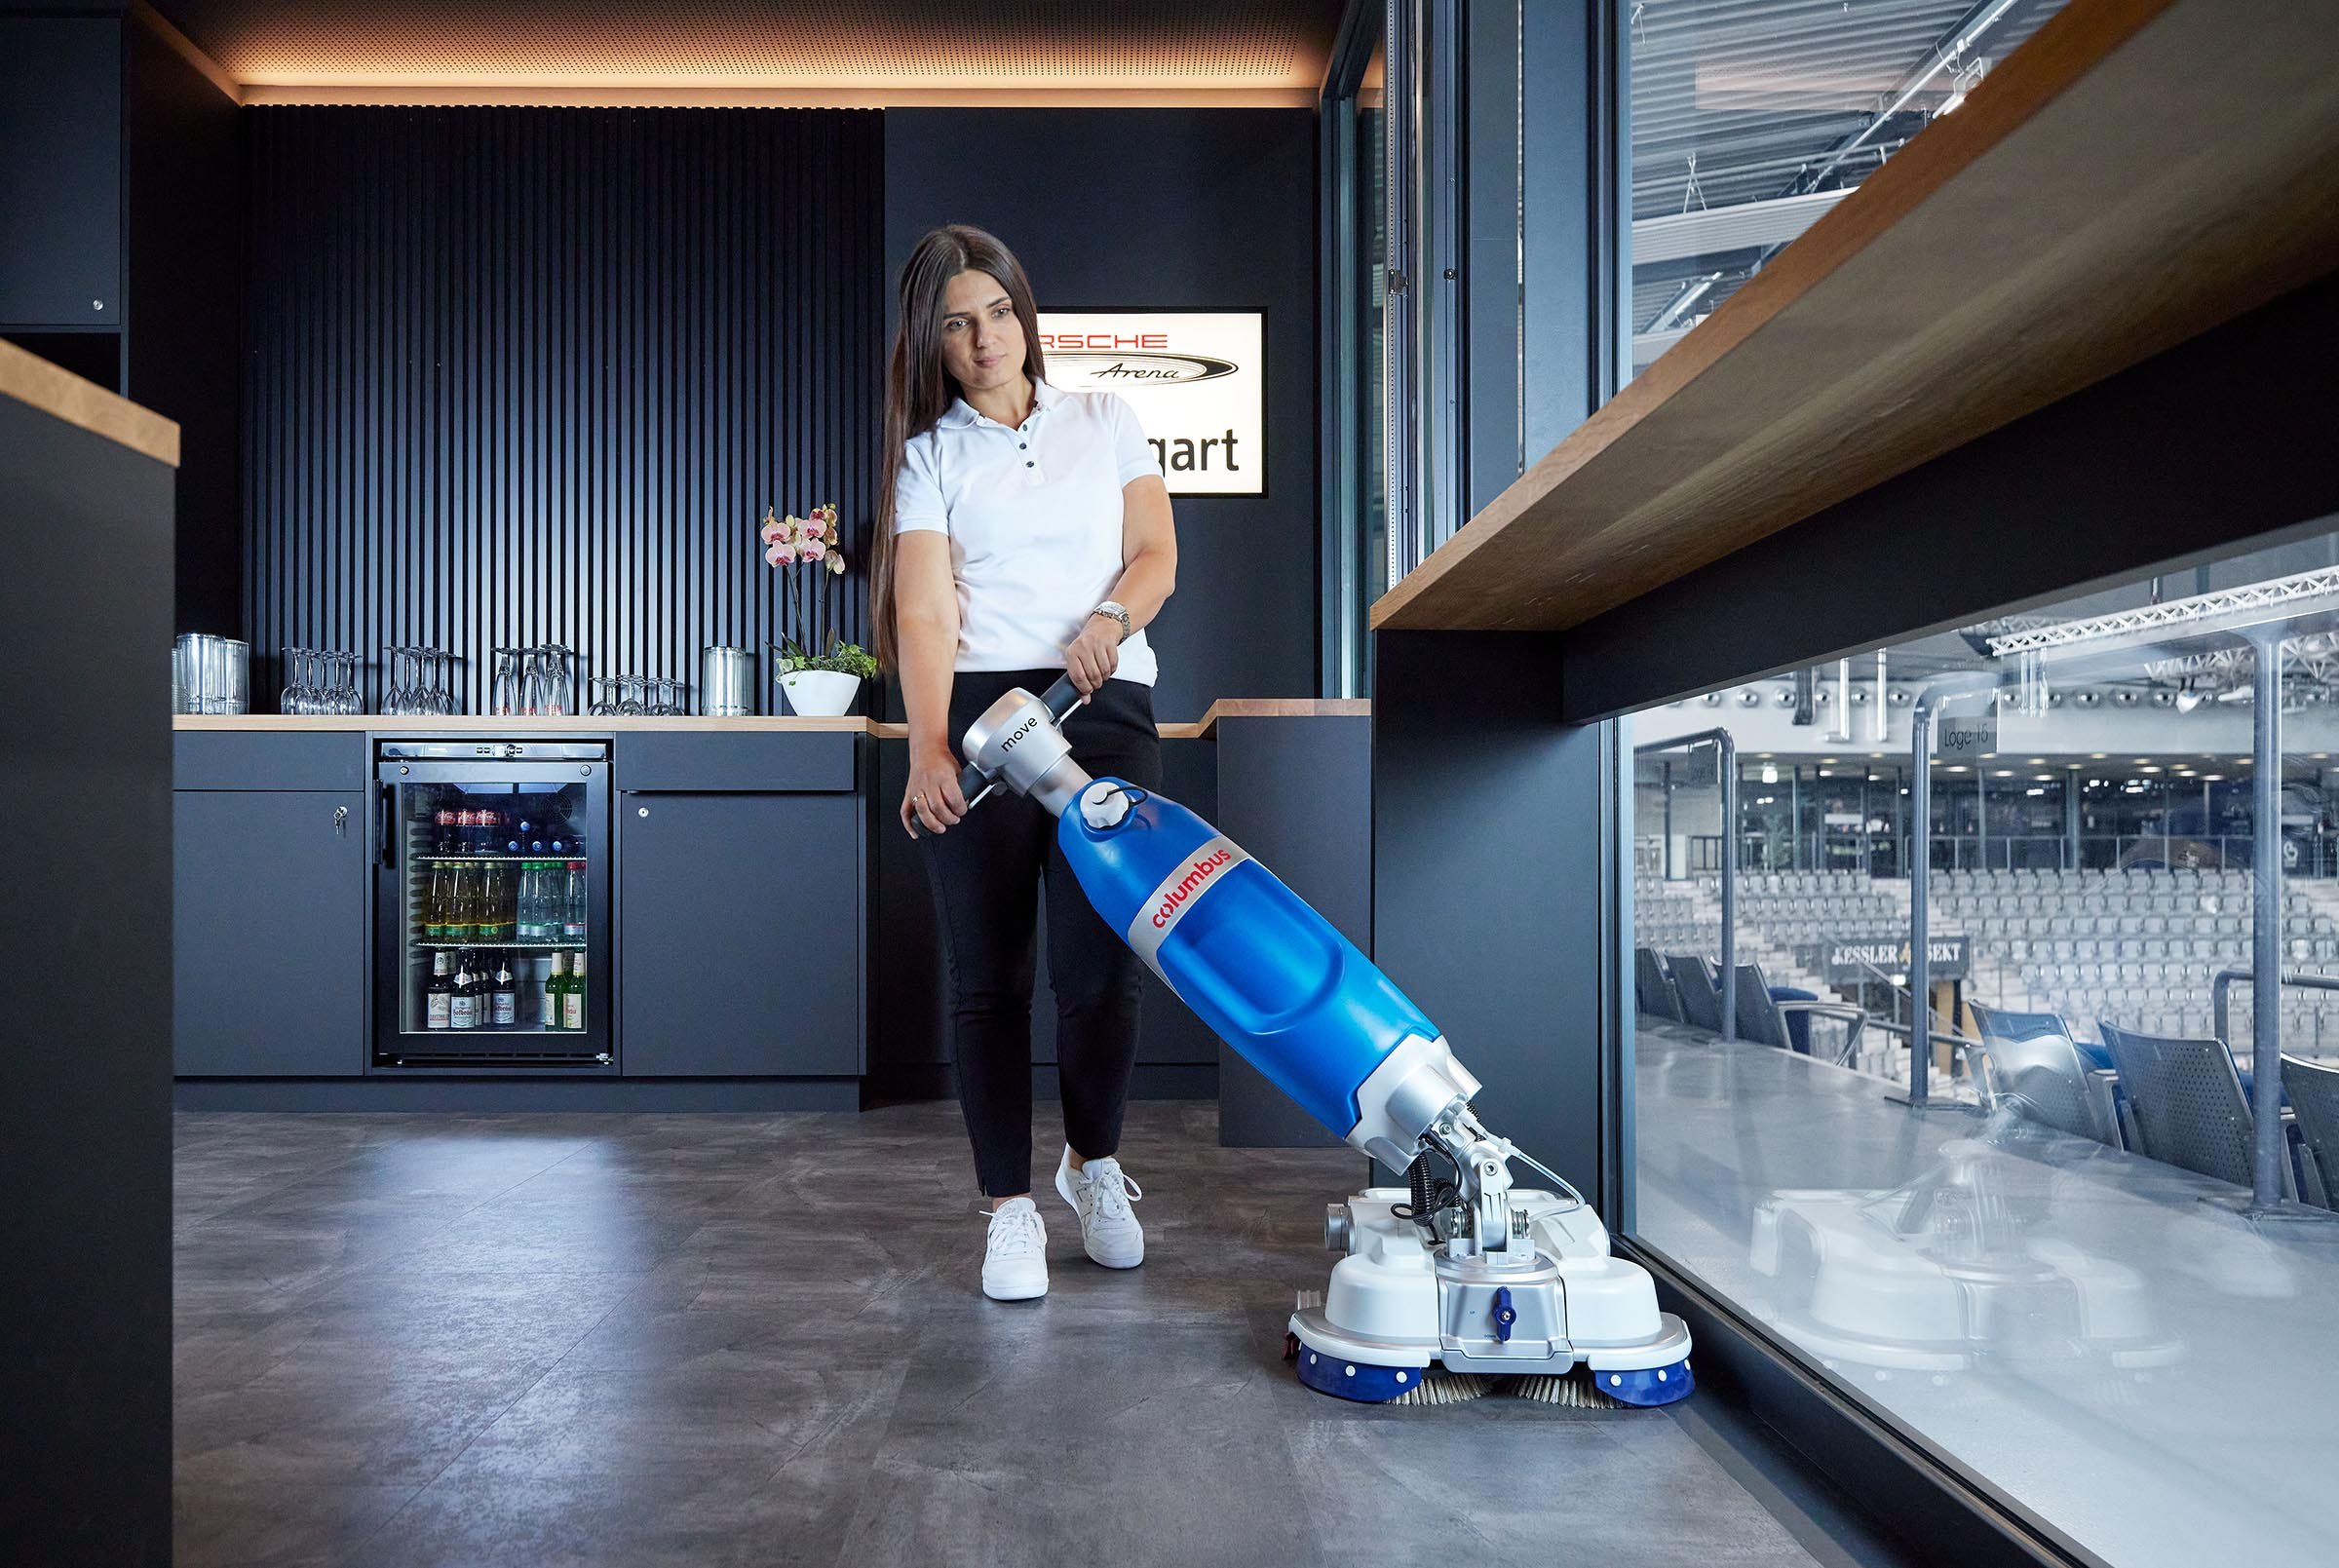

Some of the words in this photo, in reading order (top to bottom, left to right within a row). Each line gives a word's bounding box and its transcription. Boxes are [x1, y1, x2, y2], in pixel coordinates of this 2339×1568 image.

[1090, 362, 1179, 379] Arena
[1001, 716, 1038, 752] move
[1944, 727, 1972, 749] Loge
[1152, 849, 1232, 930] columbus
[1831, 944, 1898, 965] KESSLER
